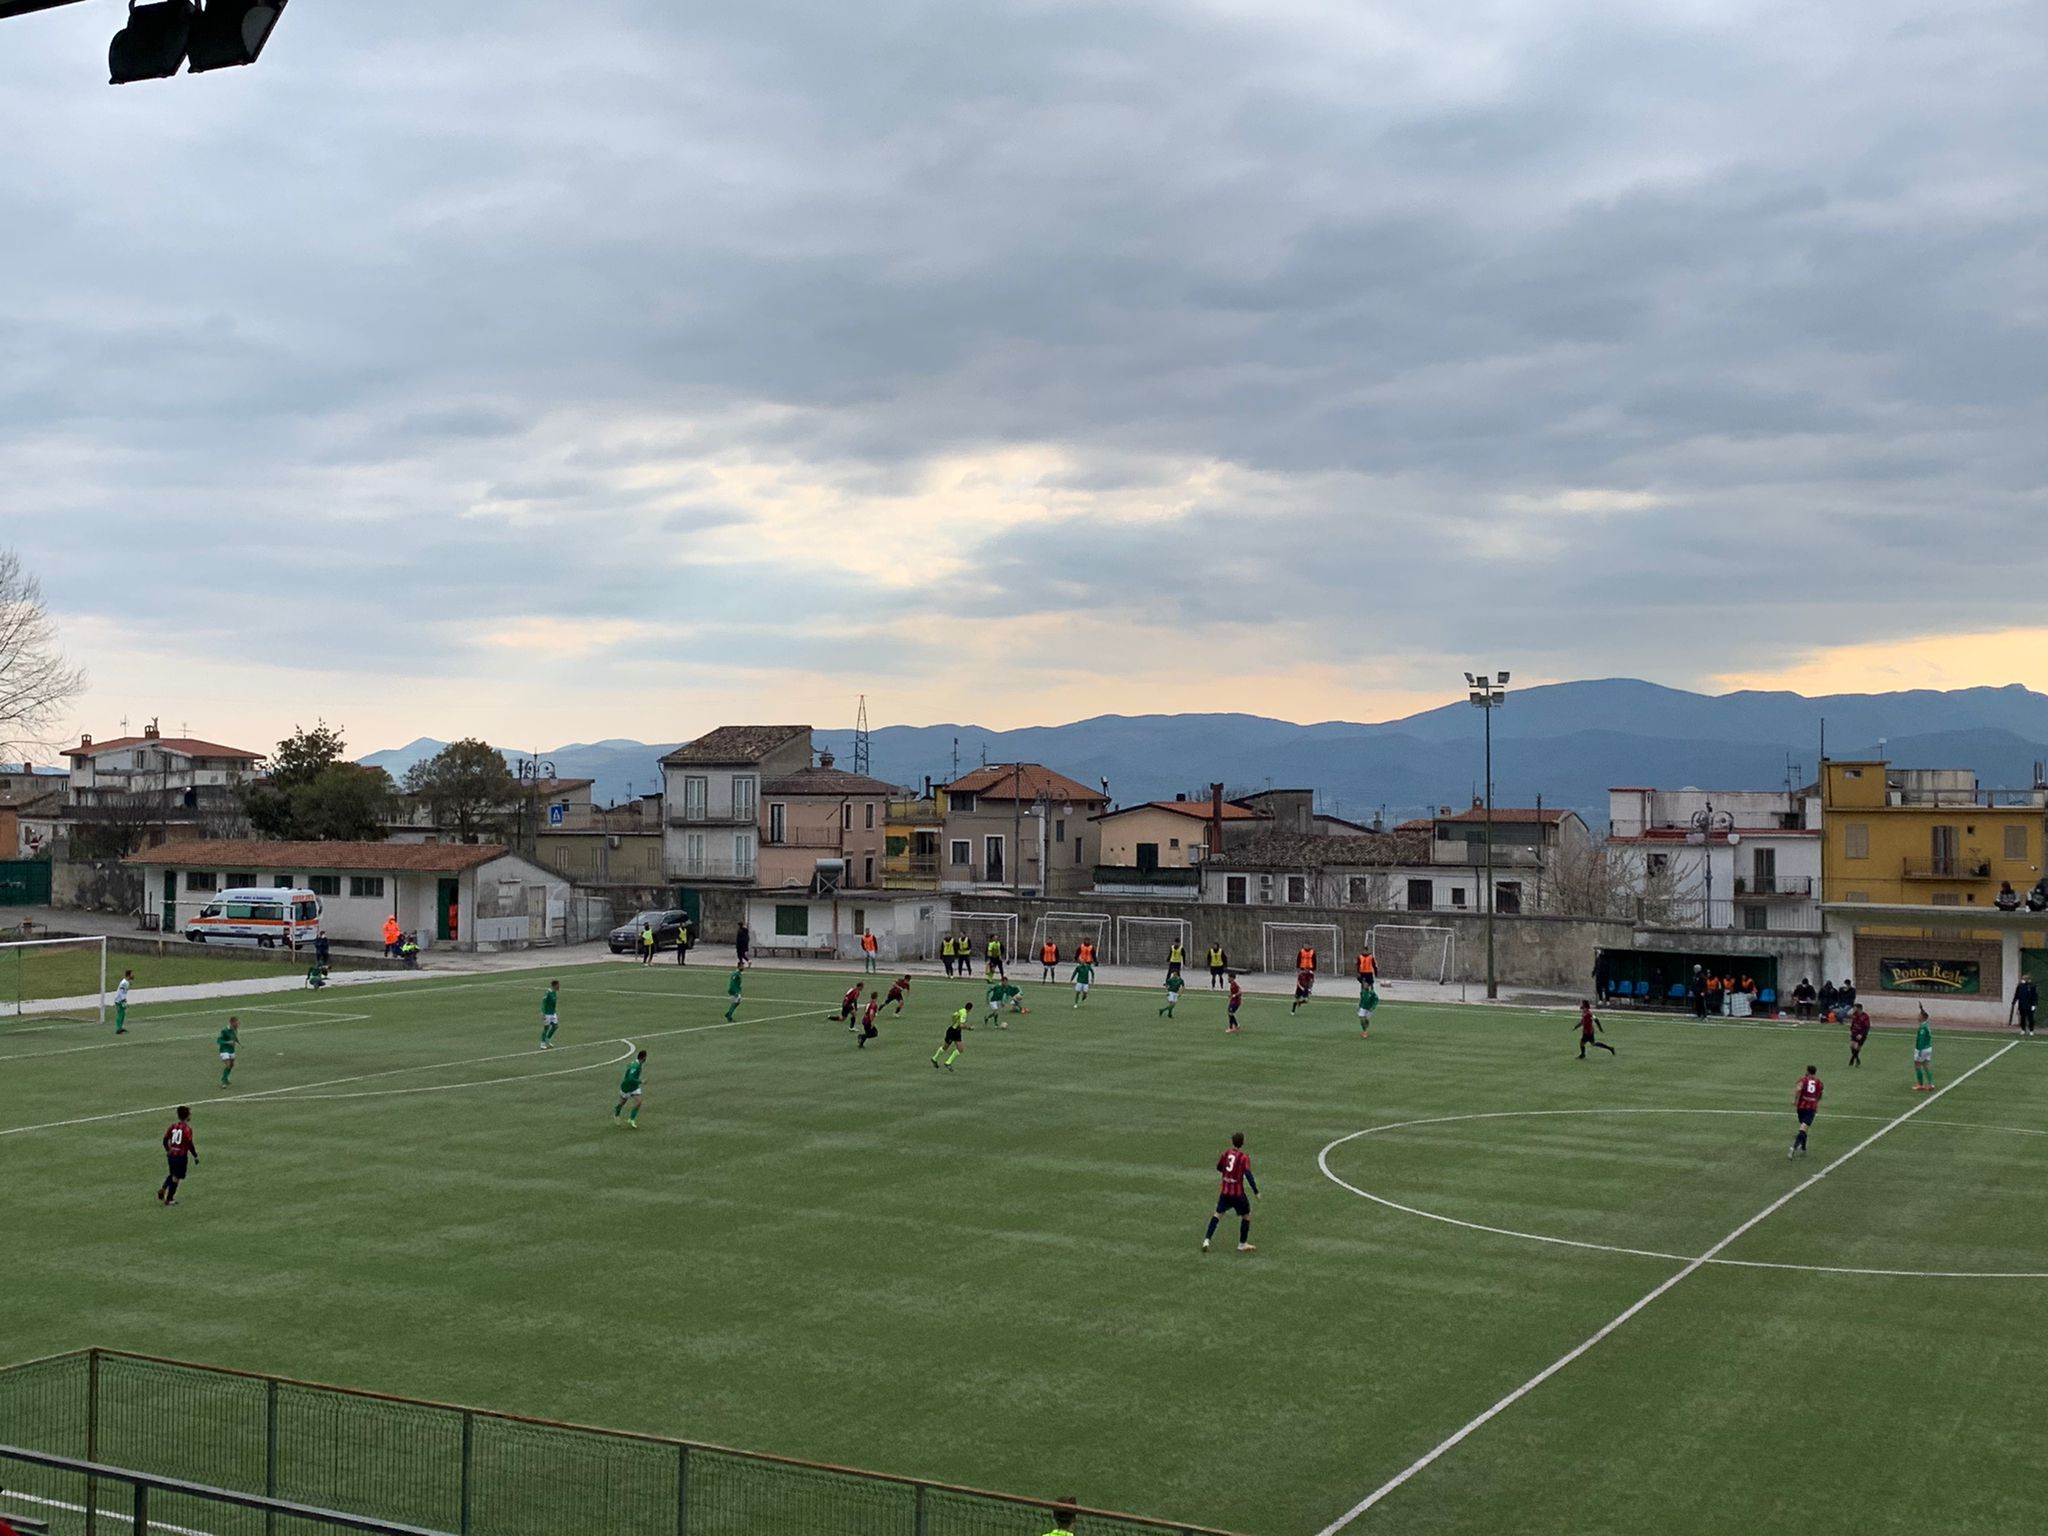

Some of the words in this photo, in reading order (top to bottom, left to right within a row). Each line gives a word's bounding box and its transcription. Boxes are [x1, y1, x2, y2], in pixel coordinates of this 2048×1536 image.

[1891, 967, 1928, 980] Ponte
[1932, 965, 1965, 984] Reale
[1807, 1079, 1816, 1094] 6
[171, 1128, 183, 1145] 10
[1225, 1153, 1236, 1172] 3
